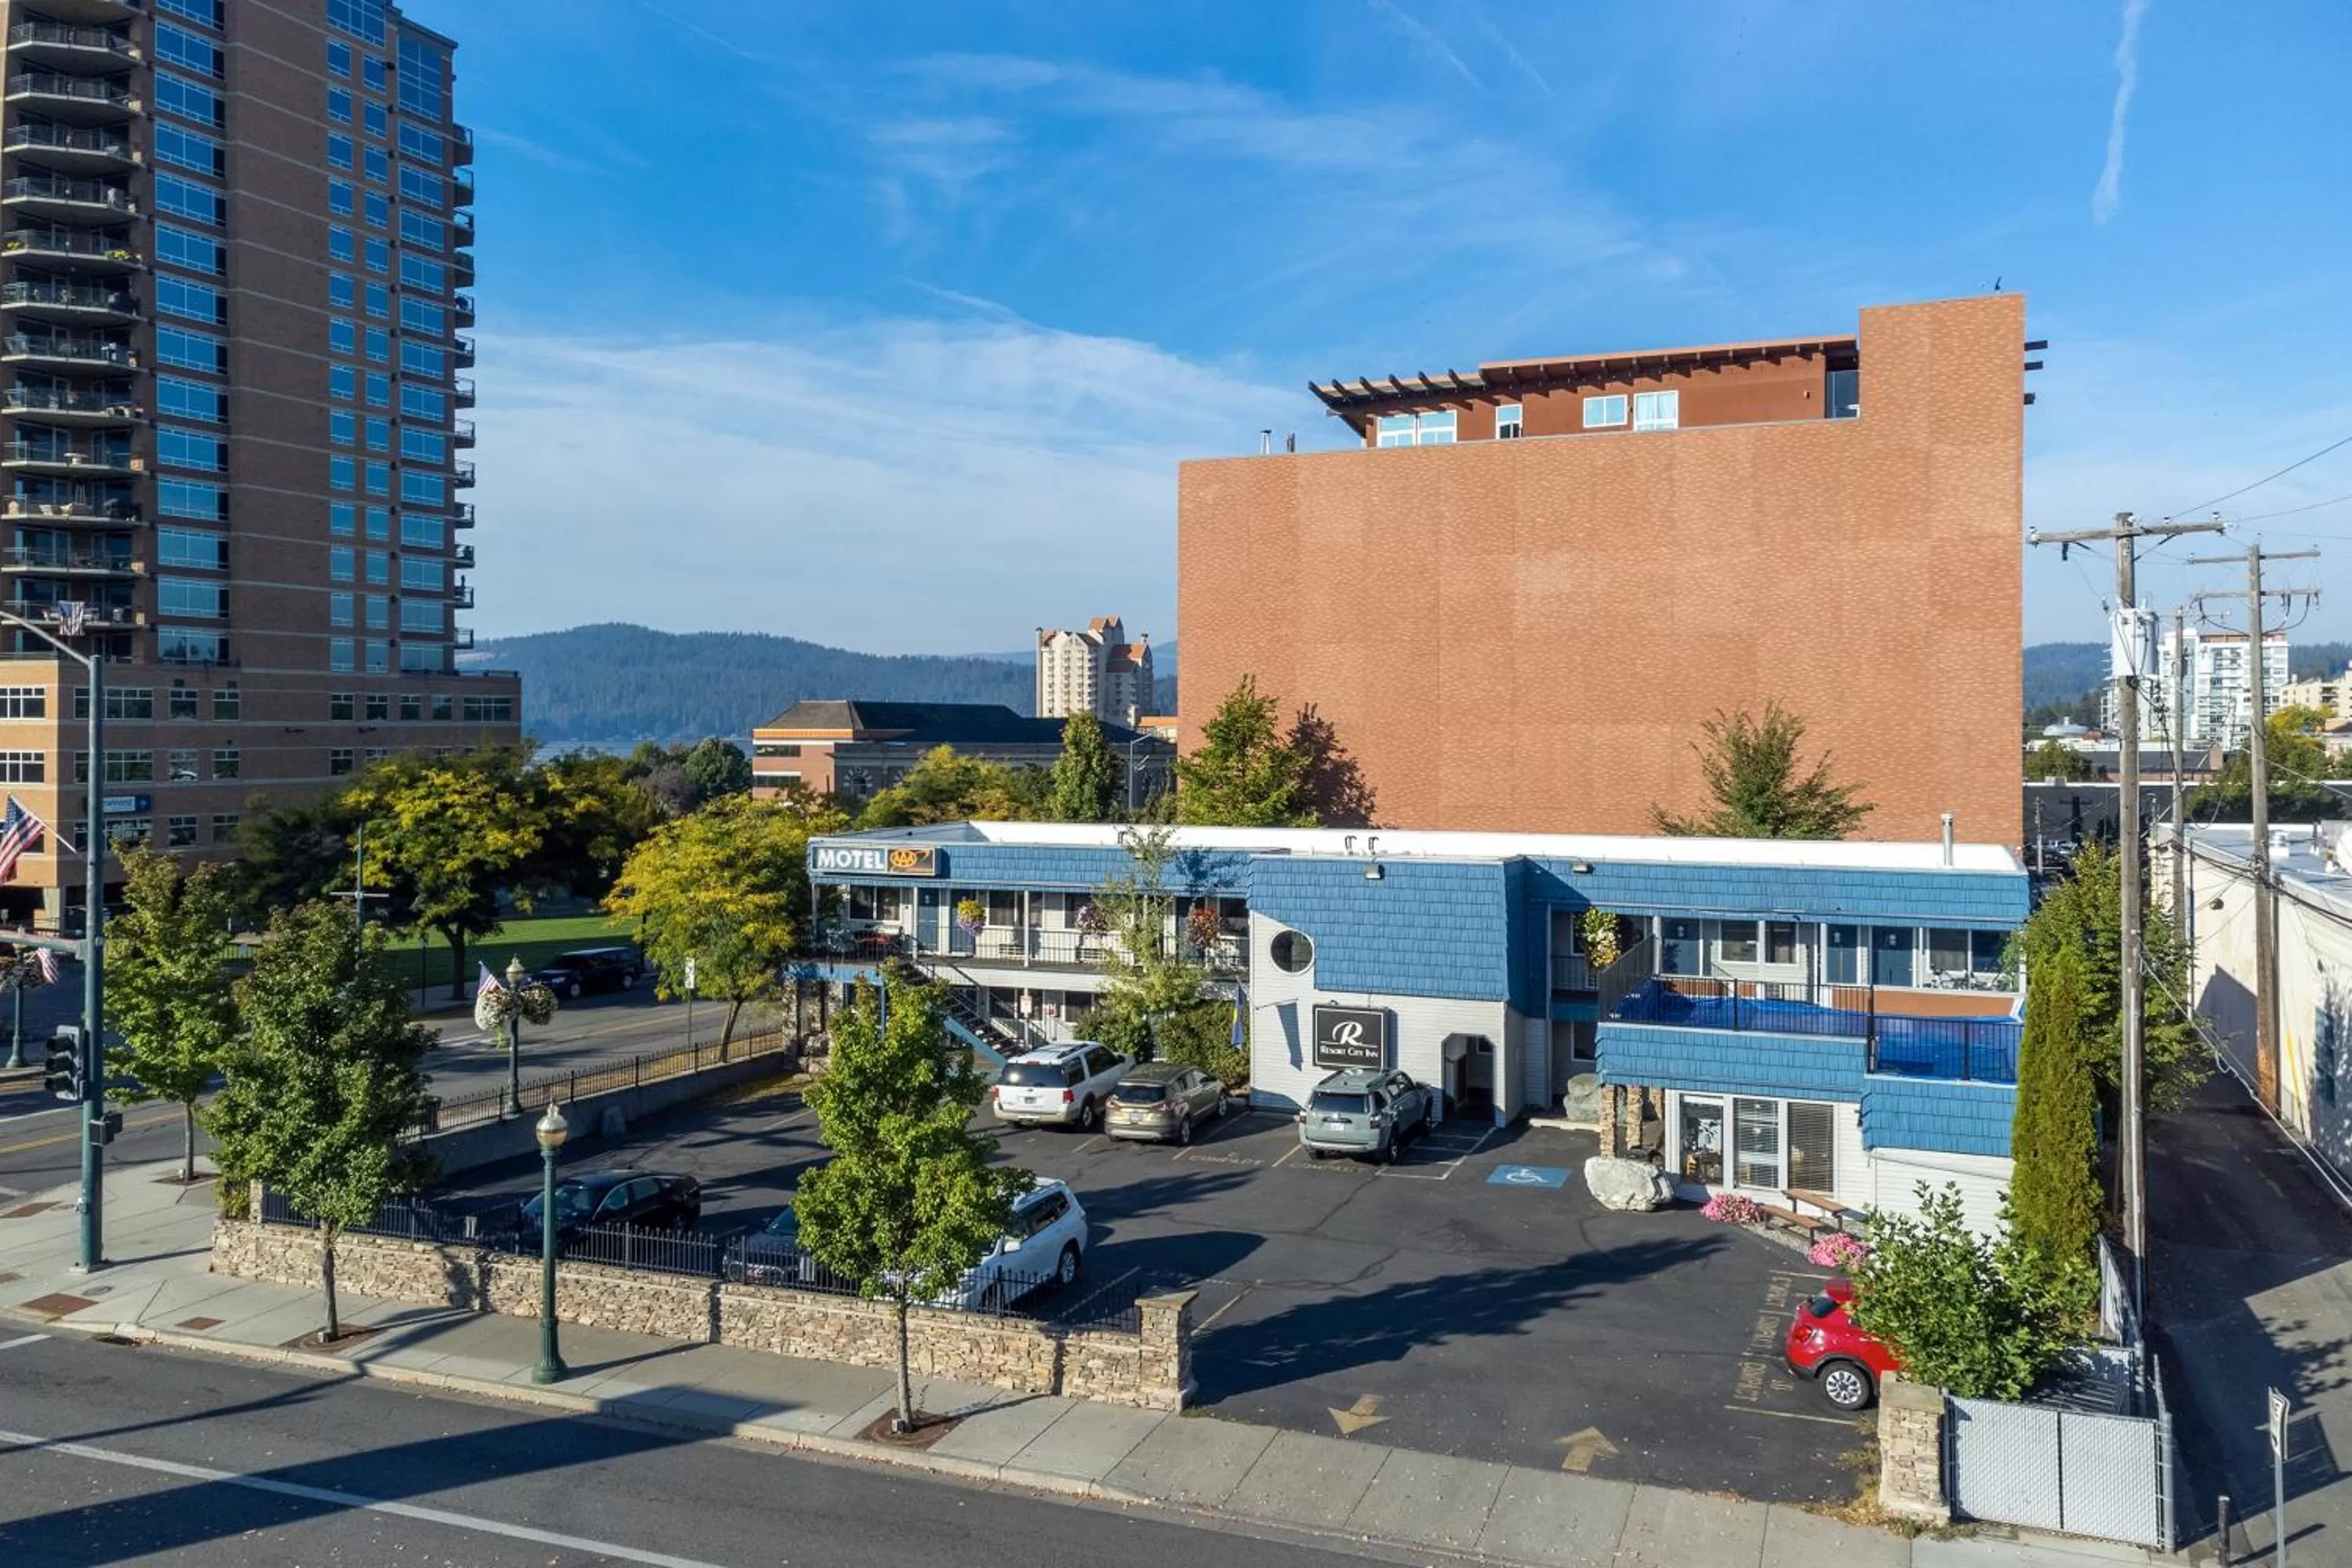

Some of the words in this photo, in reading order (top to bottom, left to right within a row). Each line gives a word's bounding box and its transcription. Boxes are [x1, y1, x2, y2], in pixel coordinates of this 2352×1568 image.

[818, 848, 885, 869] MOTEL
[892, 851, 916, 864] AAA
[1332, 1021, 1363, 1046] R
